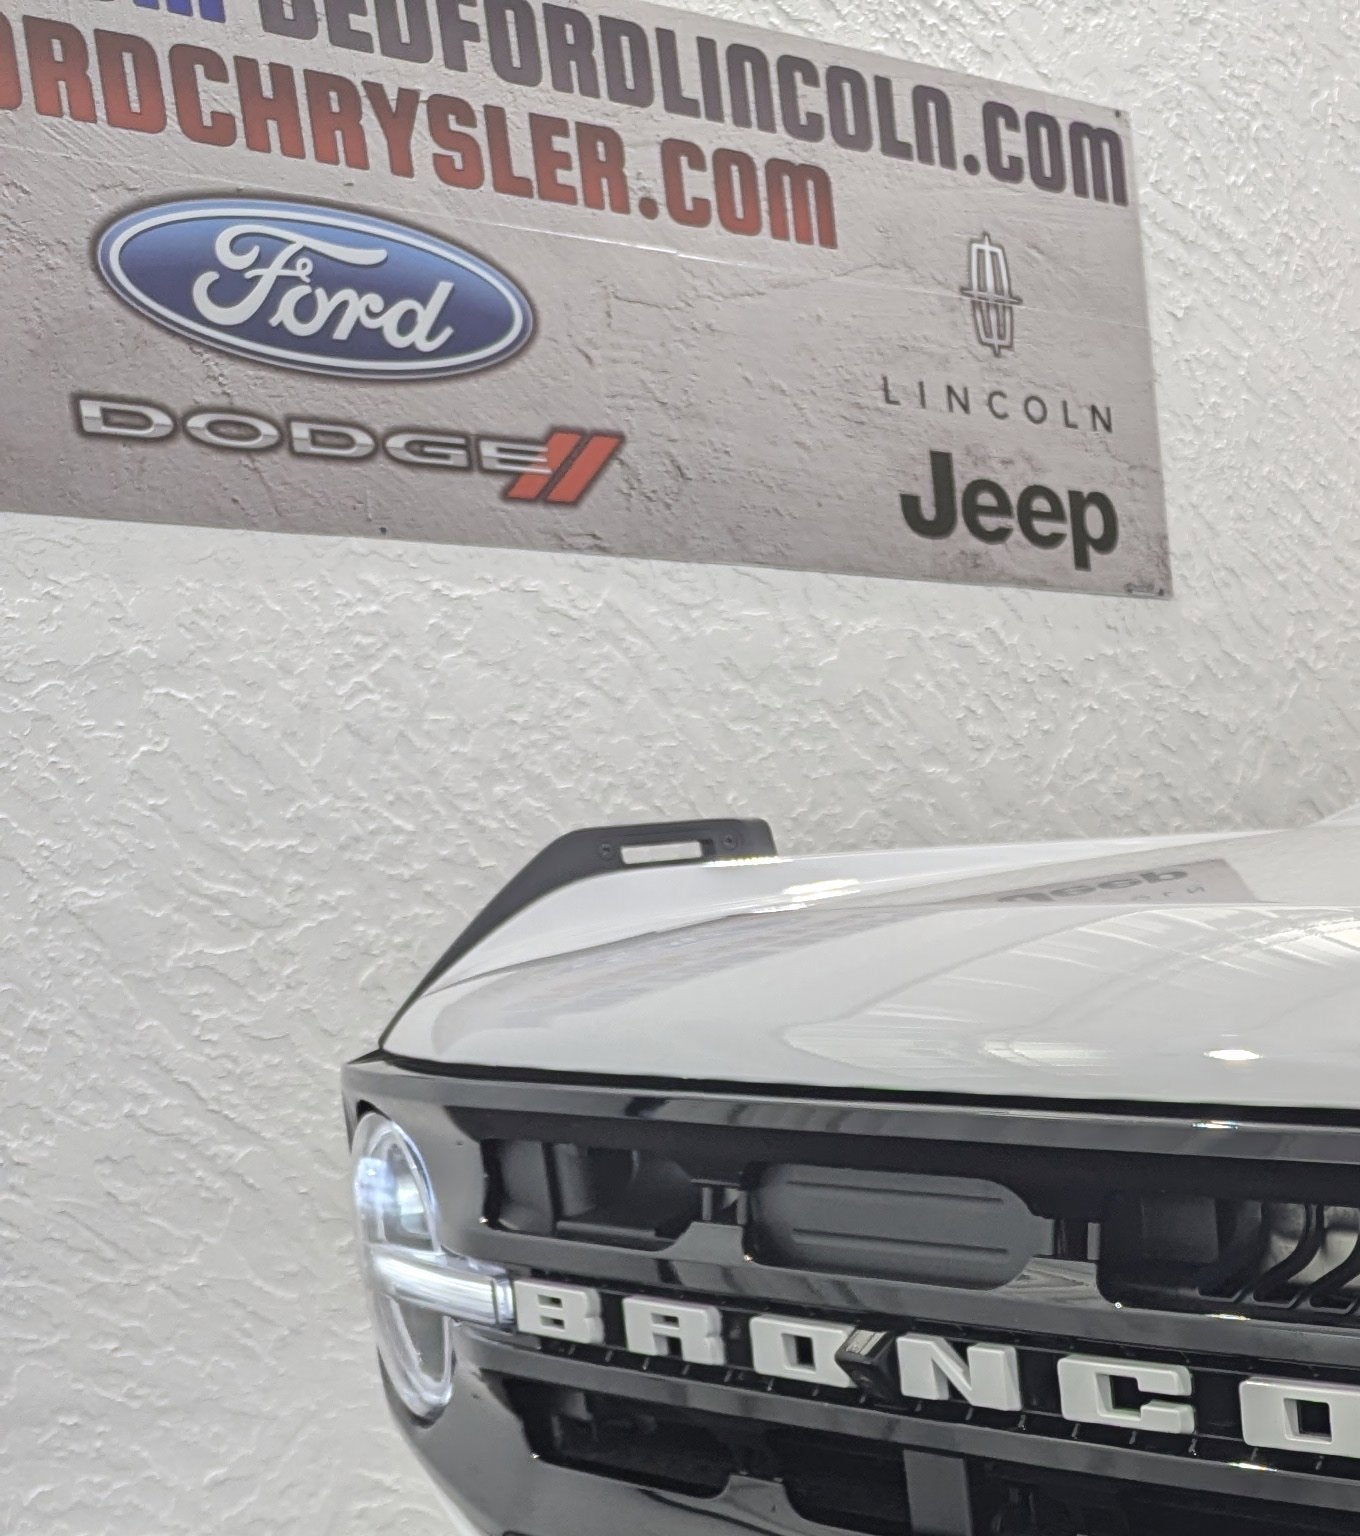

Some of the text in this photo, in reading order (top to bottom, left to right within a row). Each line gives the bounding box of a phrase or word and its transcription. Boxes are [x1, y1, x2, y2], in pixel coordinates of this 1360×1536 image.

[192, 224, 454, 353] Ford
[75, 399, 553, 475] DODGE
[882, 375, 1113, 433] LINCOLN
[900, 450, 1119, 572] Jeep
